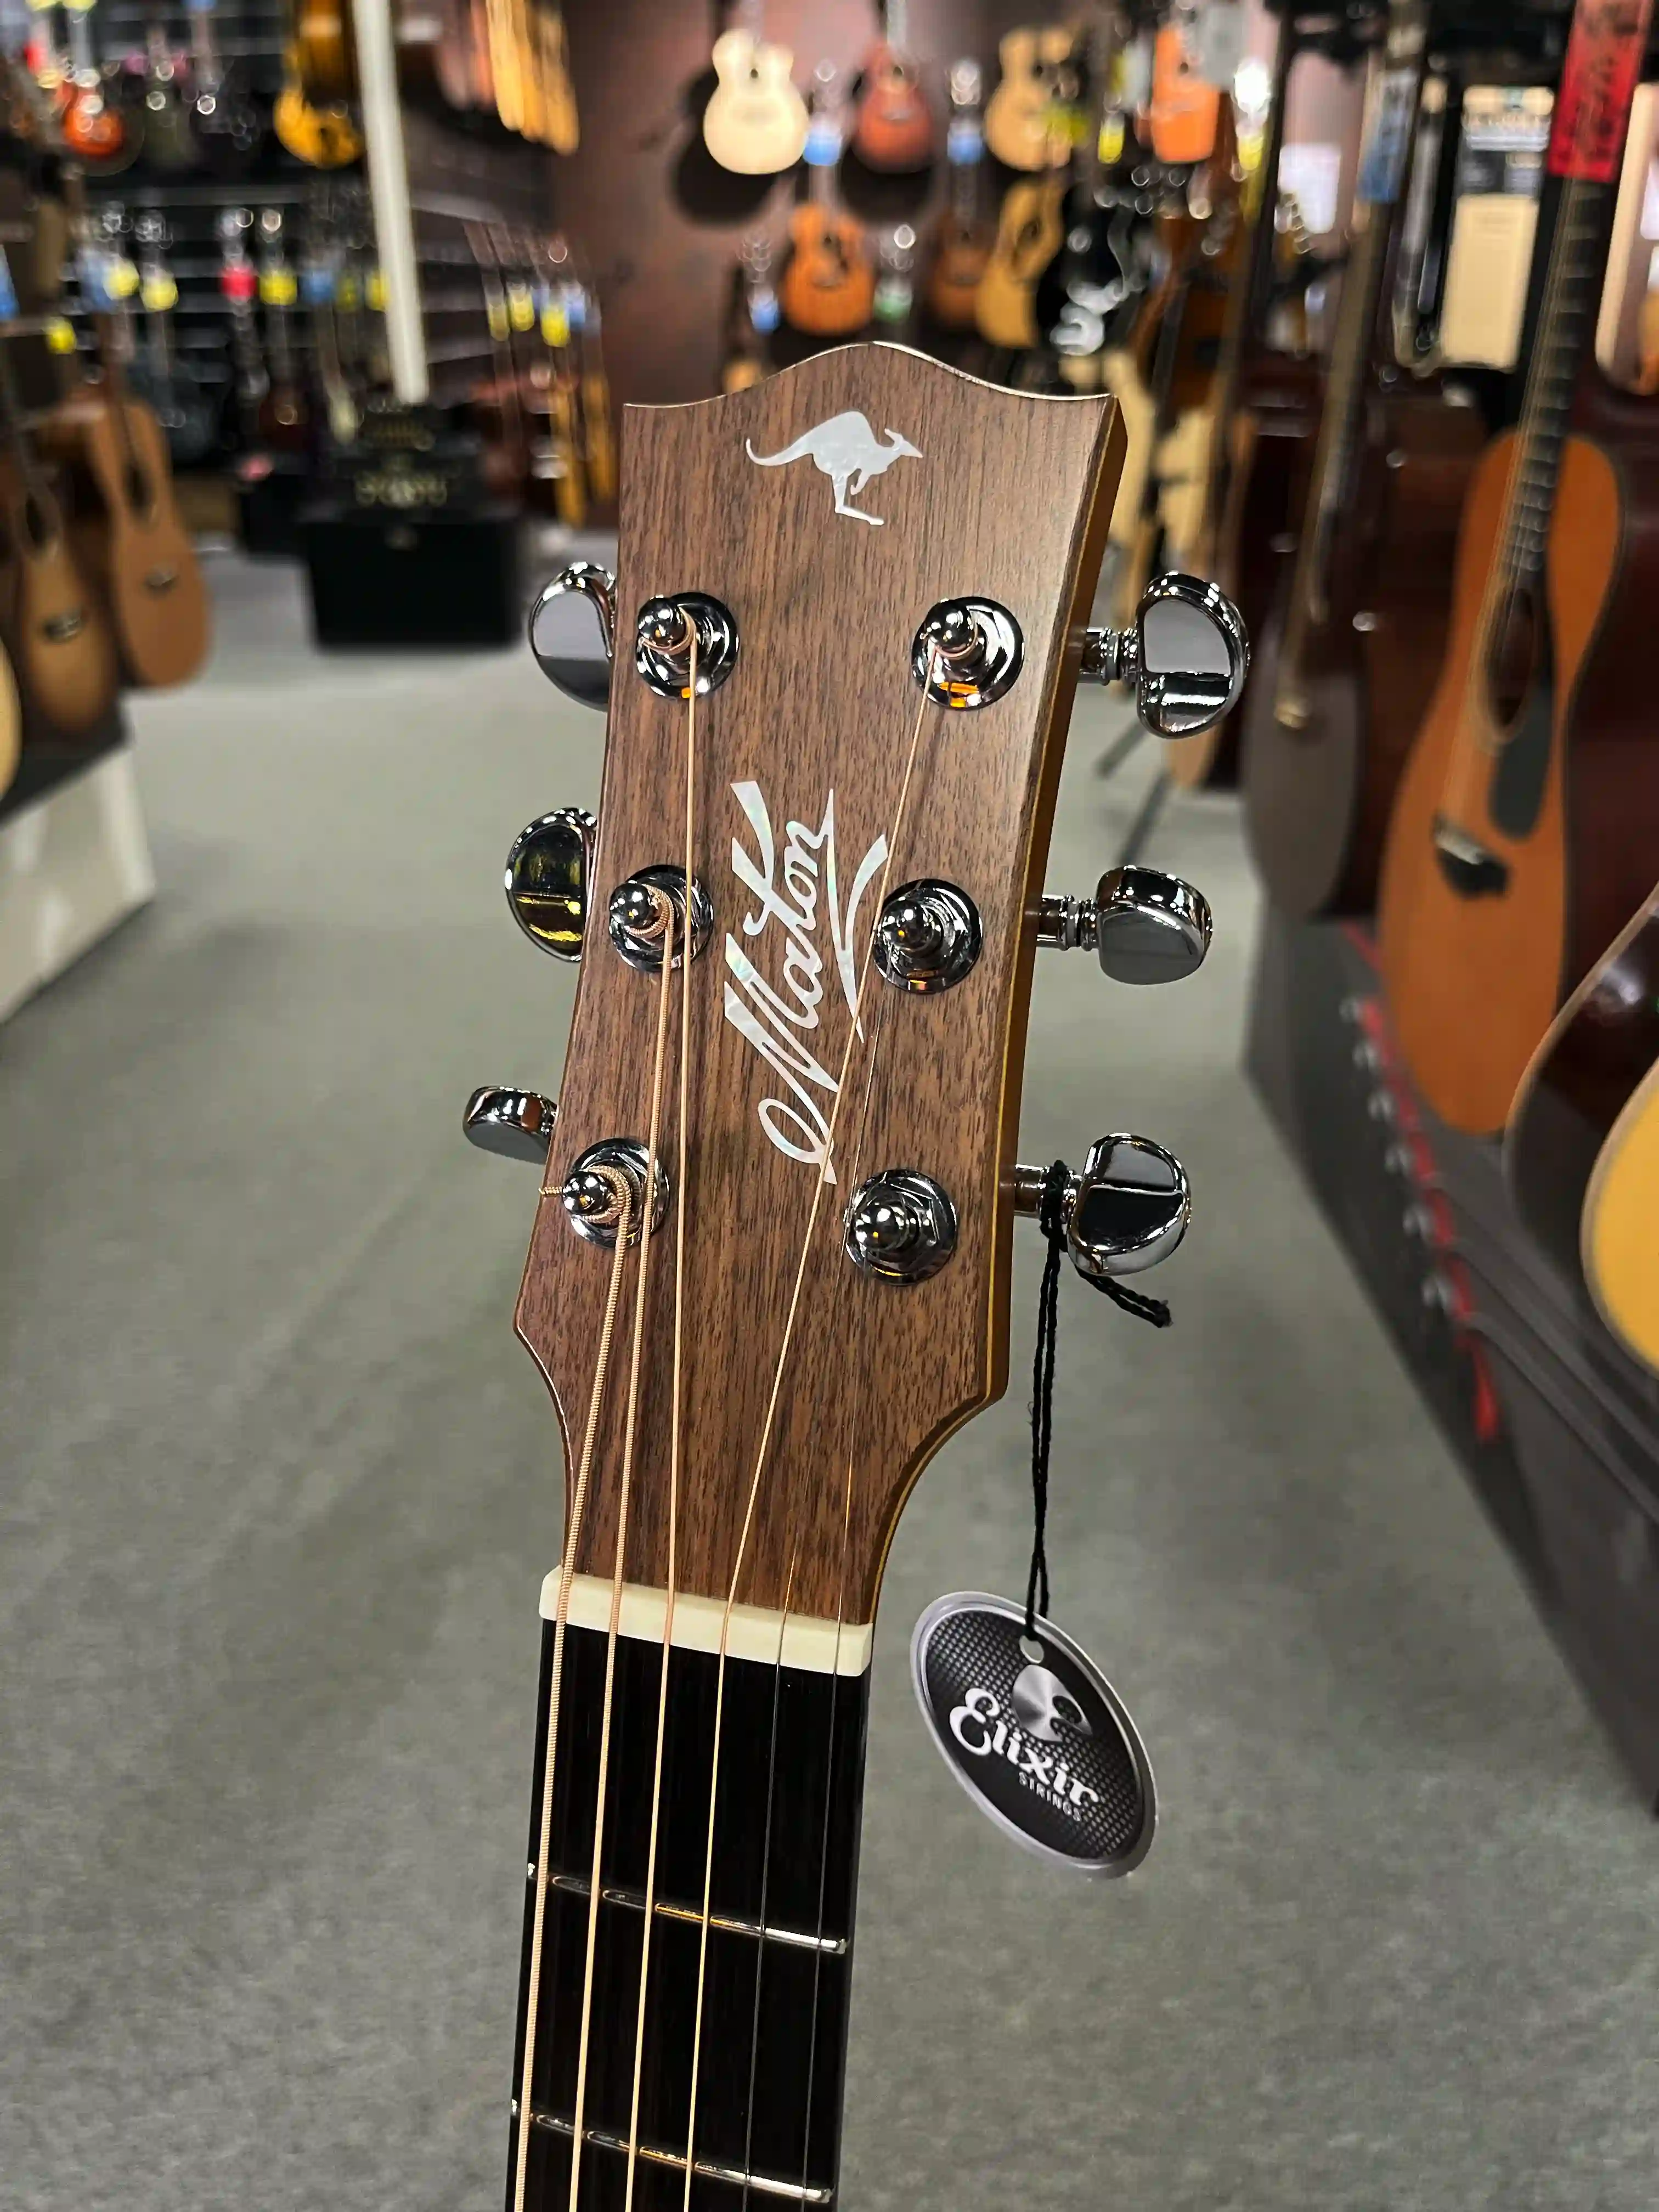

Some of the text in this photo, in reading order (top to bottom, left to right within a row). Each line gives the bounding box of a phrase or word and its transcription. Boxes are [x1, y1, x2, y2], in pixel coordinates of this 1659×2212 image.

[724, 781, 888, 1184] Maton
[950, 1688, 1099, 1806] Elixir
[1019, 1772, 1082, 1821] STRINGS
